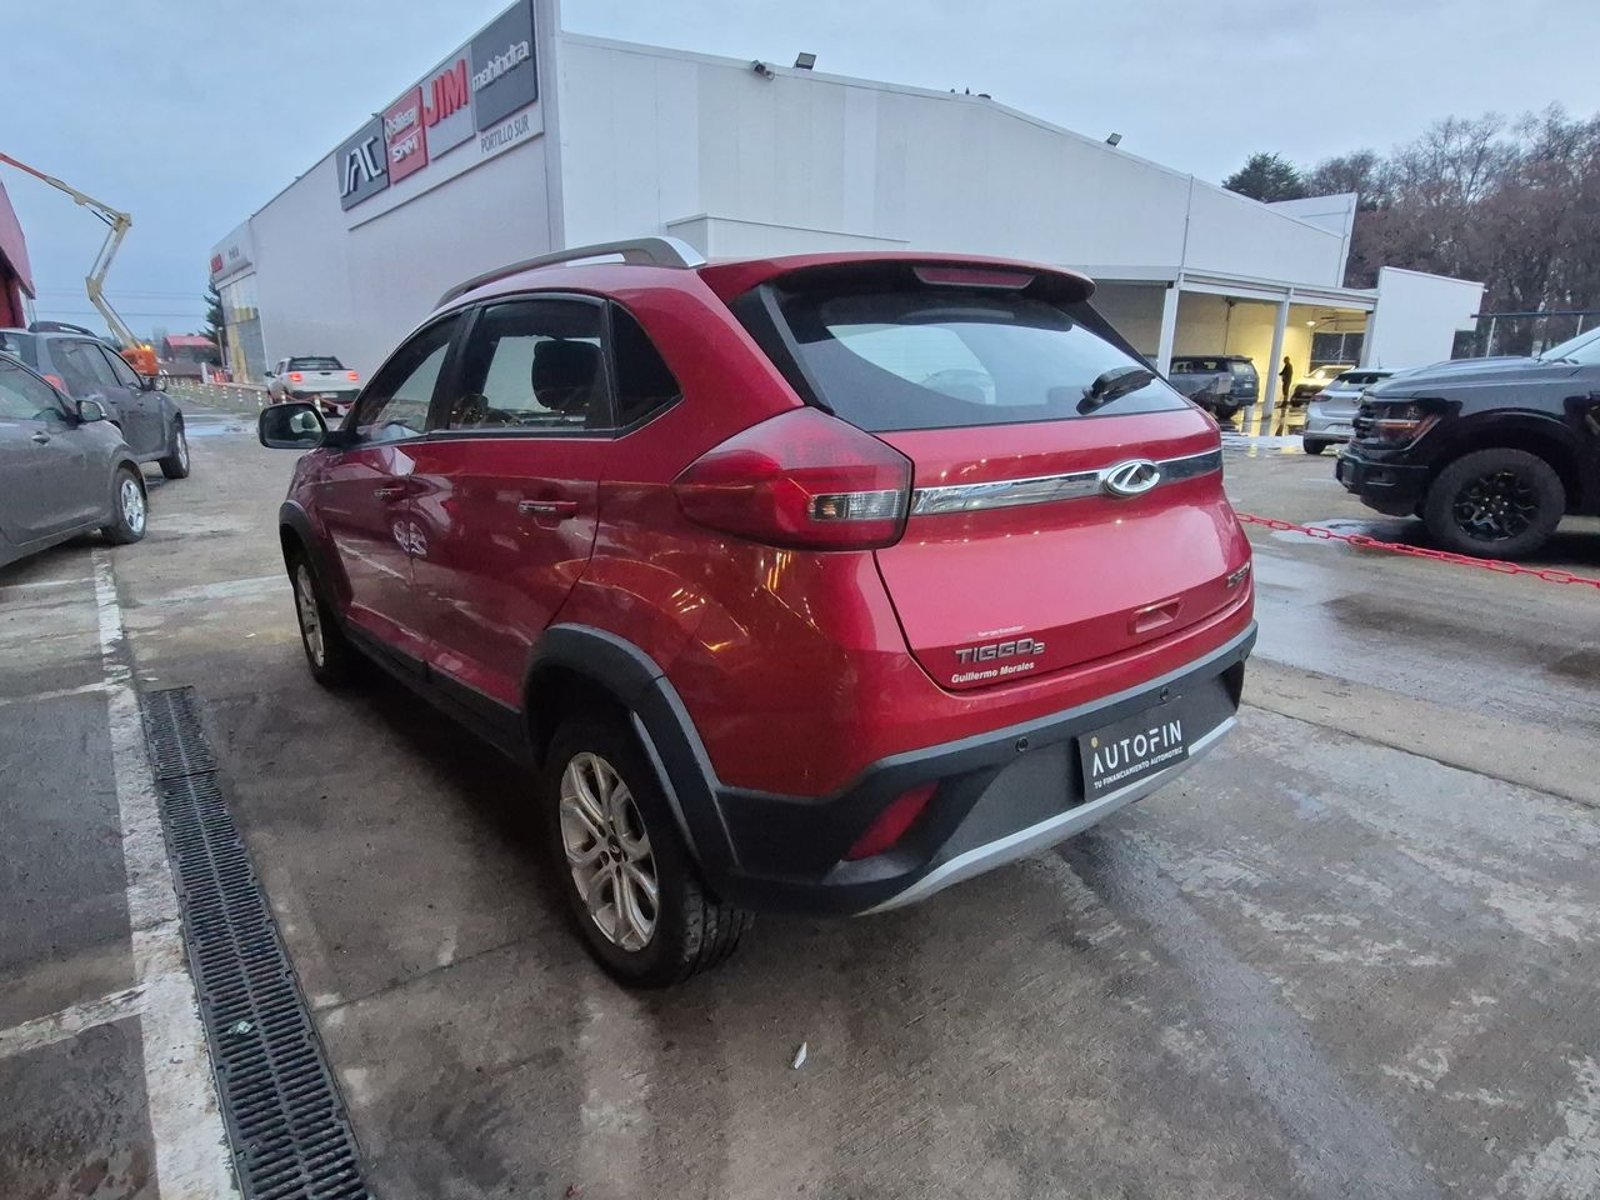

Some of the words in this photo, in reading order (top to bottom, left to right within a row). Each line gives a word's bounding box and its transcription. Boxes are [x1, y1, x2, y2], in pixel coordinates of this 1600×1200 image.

[472, 40, 530, 91] mahindra
[424, 58, 469, 127] JIM
[480, 123, 514, 154] PORTILLO
[514, 114, 530, 138] SUR
[951, 668, 998, 683] Guillermo
[999, 661, 1035, 675] Morales
[1092, 719, 1182, 777] AUTOFIN
[1093, 780, 1103, 789] TU
[1103, 760, 1150, 785] FINANCIAMIENTO
[1150, 745, 1184, 765] AUTOMOTRIZ
